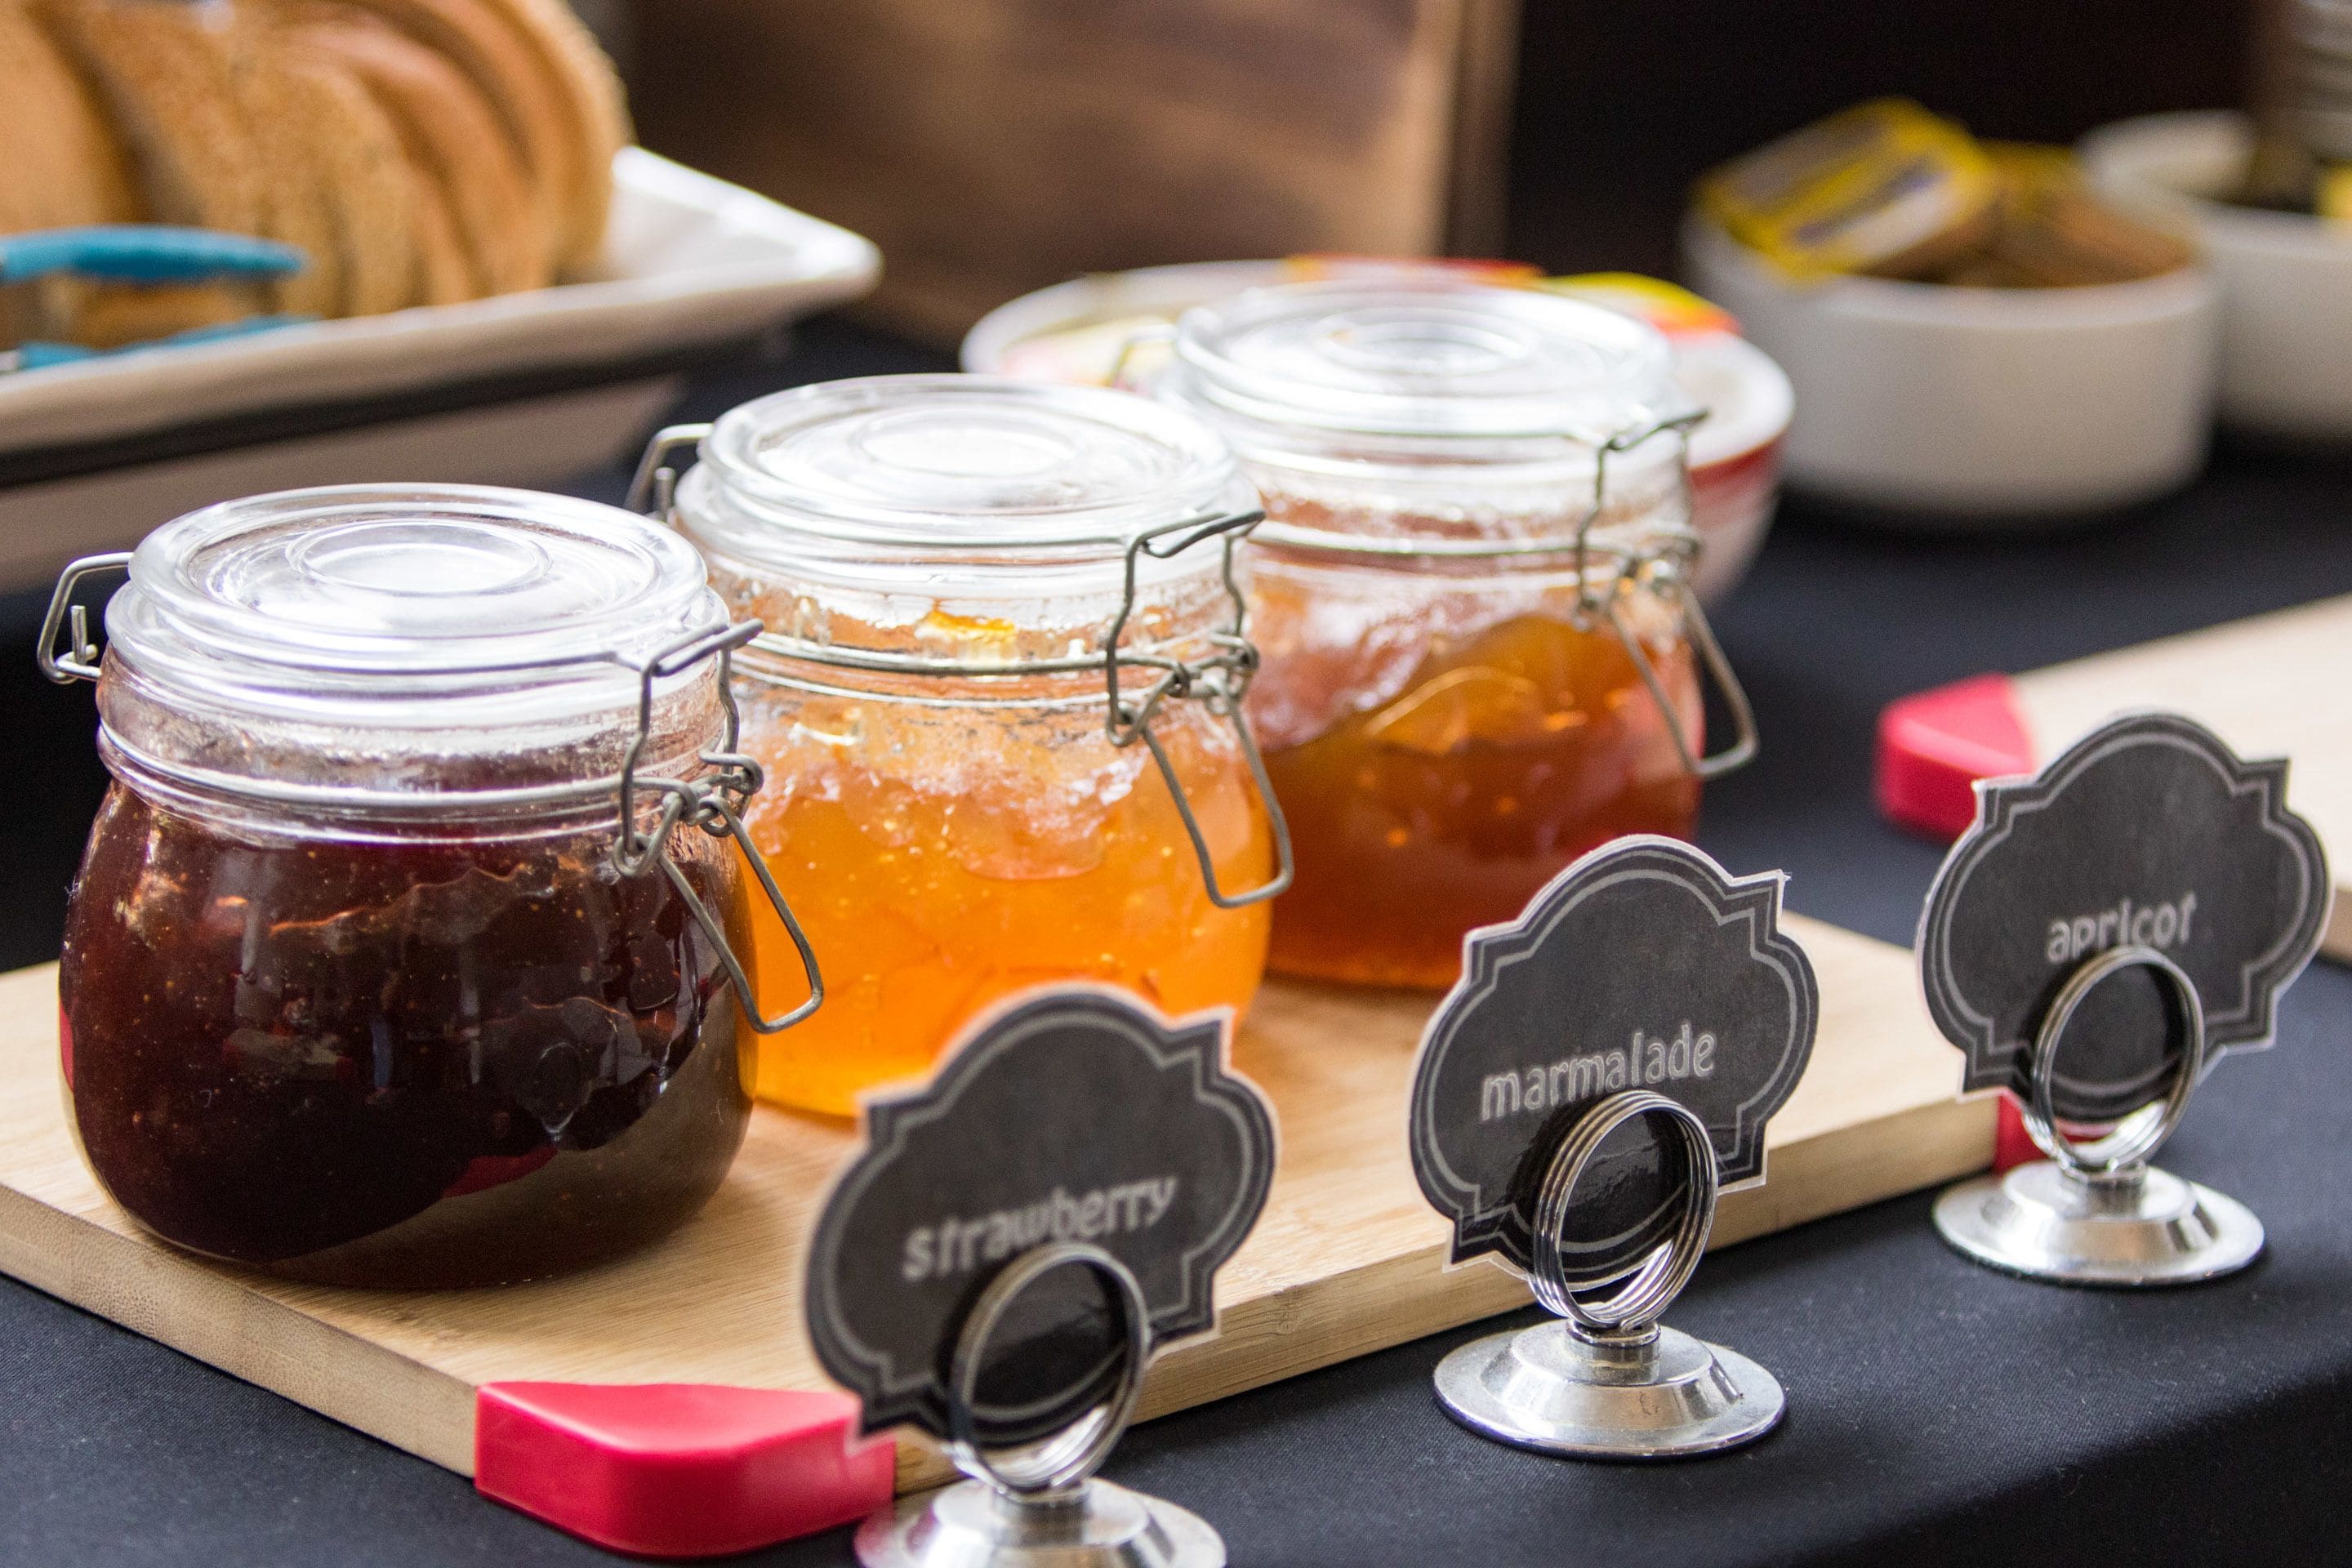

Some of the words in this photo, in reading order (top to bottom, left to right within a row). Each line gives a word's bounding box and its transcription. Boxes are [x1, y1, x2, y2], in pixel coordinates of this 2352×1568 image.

[2047, 891, 2197, 964] apricot
[1481, 1023, 1717, 1122] marmalade
[902, 1176, 1178, 1281] strawberry
